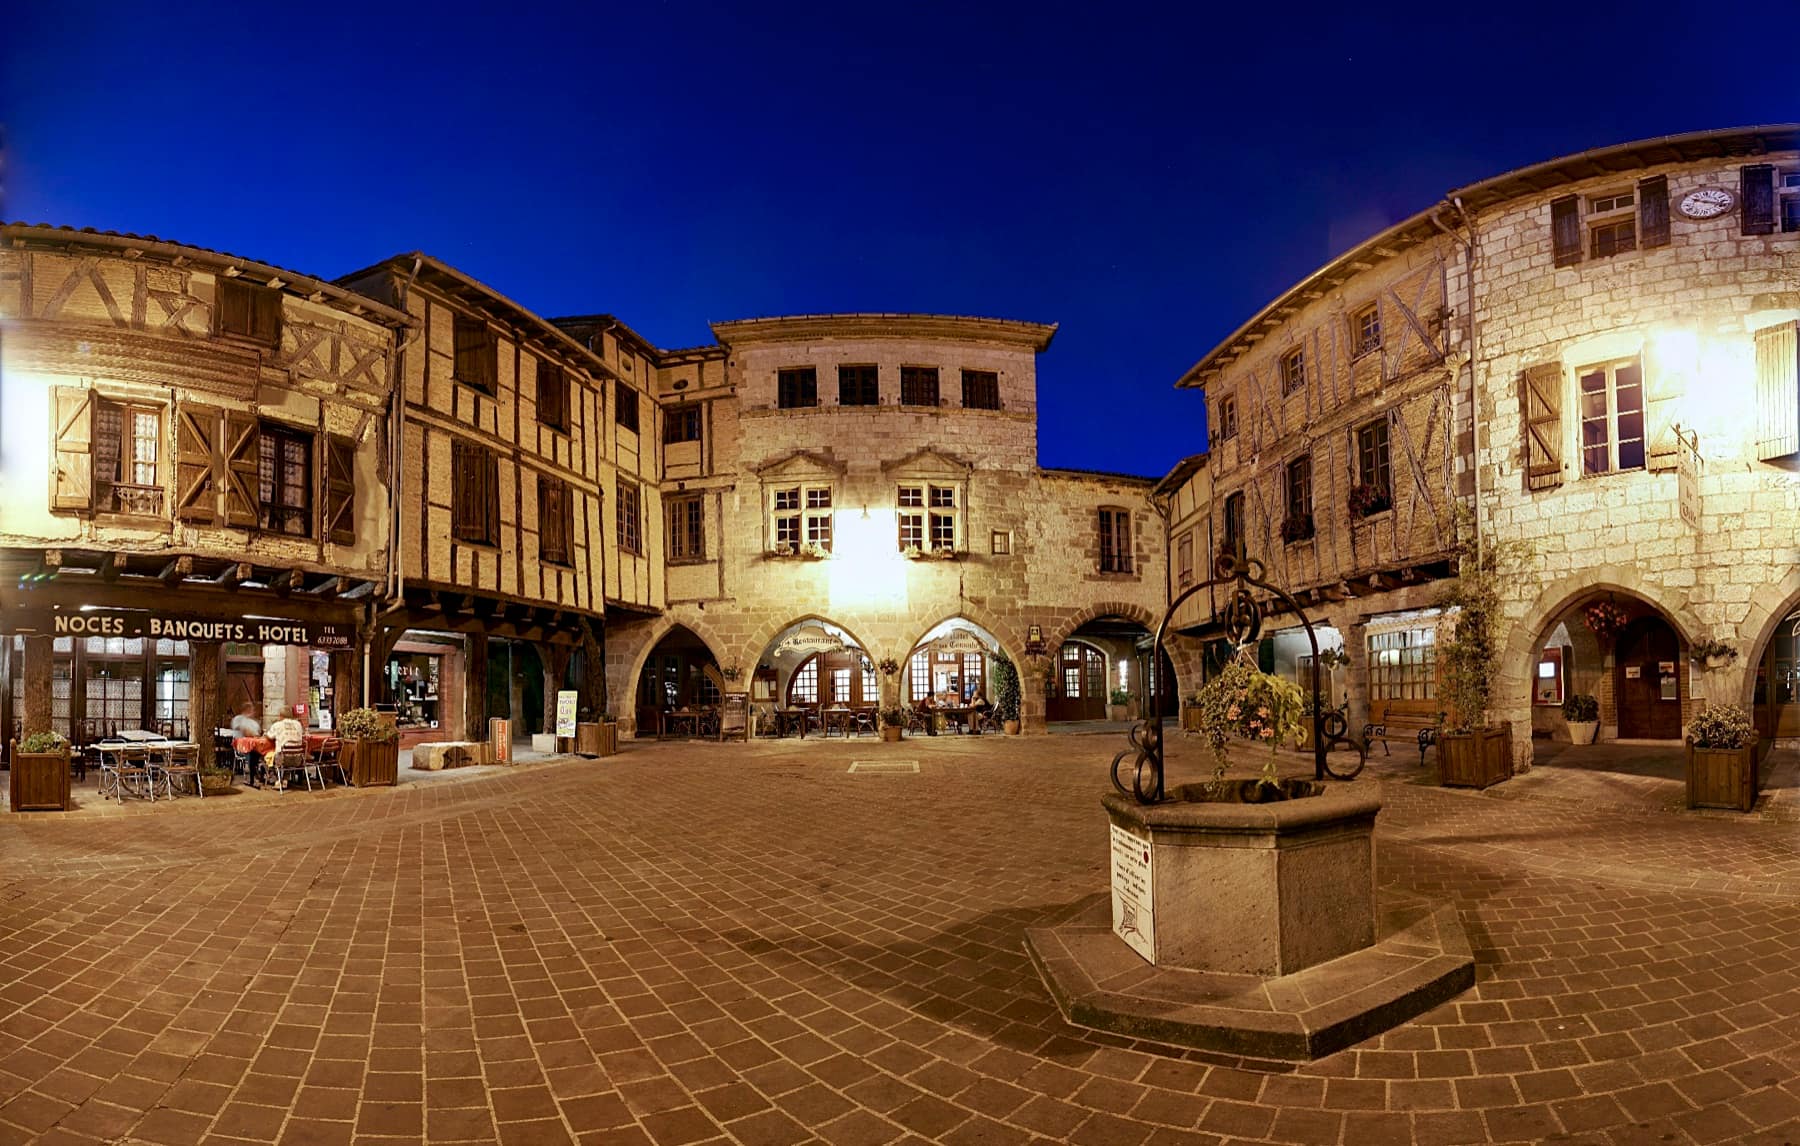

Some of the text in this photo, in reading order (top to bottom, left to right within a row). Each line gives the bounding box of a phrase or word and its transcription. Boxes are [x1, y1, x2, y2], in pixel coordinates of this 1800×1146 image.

[54, 615, 124, 634] NOCES
[150, 618, 244, 640] BANQUETS
[258, 625, 308, 643] HOTEL
